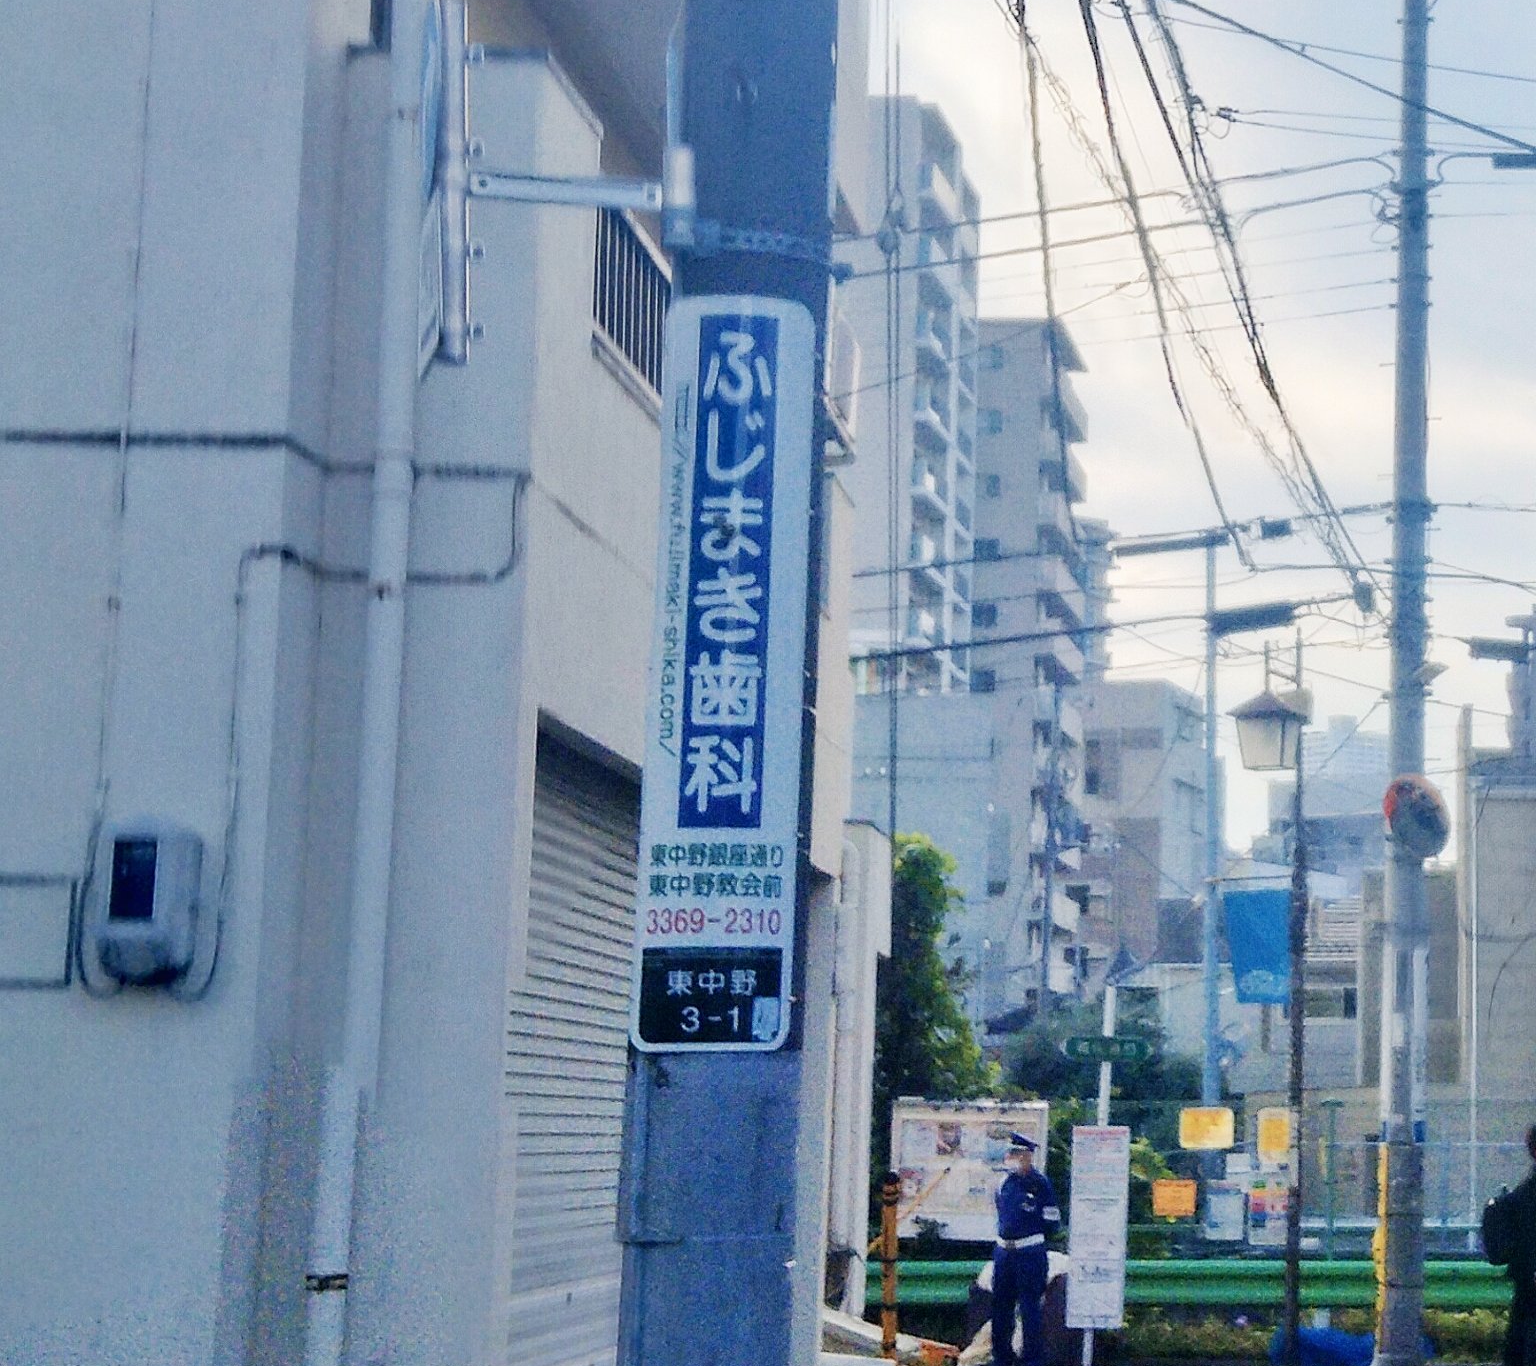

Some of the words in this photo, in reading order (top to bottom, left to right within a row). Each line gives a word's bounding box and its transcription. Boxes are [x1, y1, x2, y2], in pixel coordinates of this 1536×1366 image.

[683, 329, 772, 814] ふじまき歯科
[650, 842, 784, 868] 東中野銀座通り
[648, 873, 783, 899] 東中野教会前
[646, 907, 782, 935] 3369-2310
[666, 969, 758, 997] 東中野
[680, 1006, 740, 1033] 3-1
